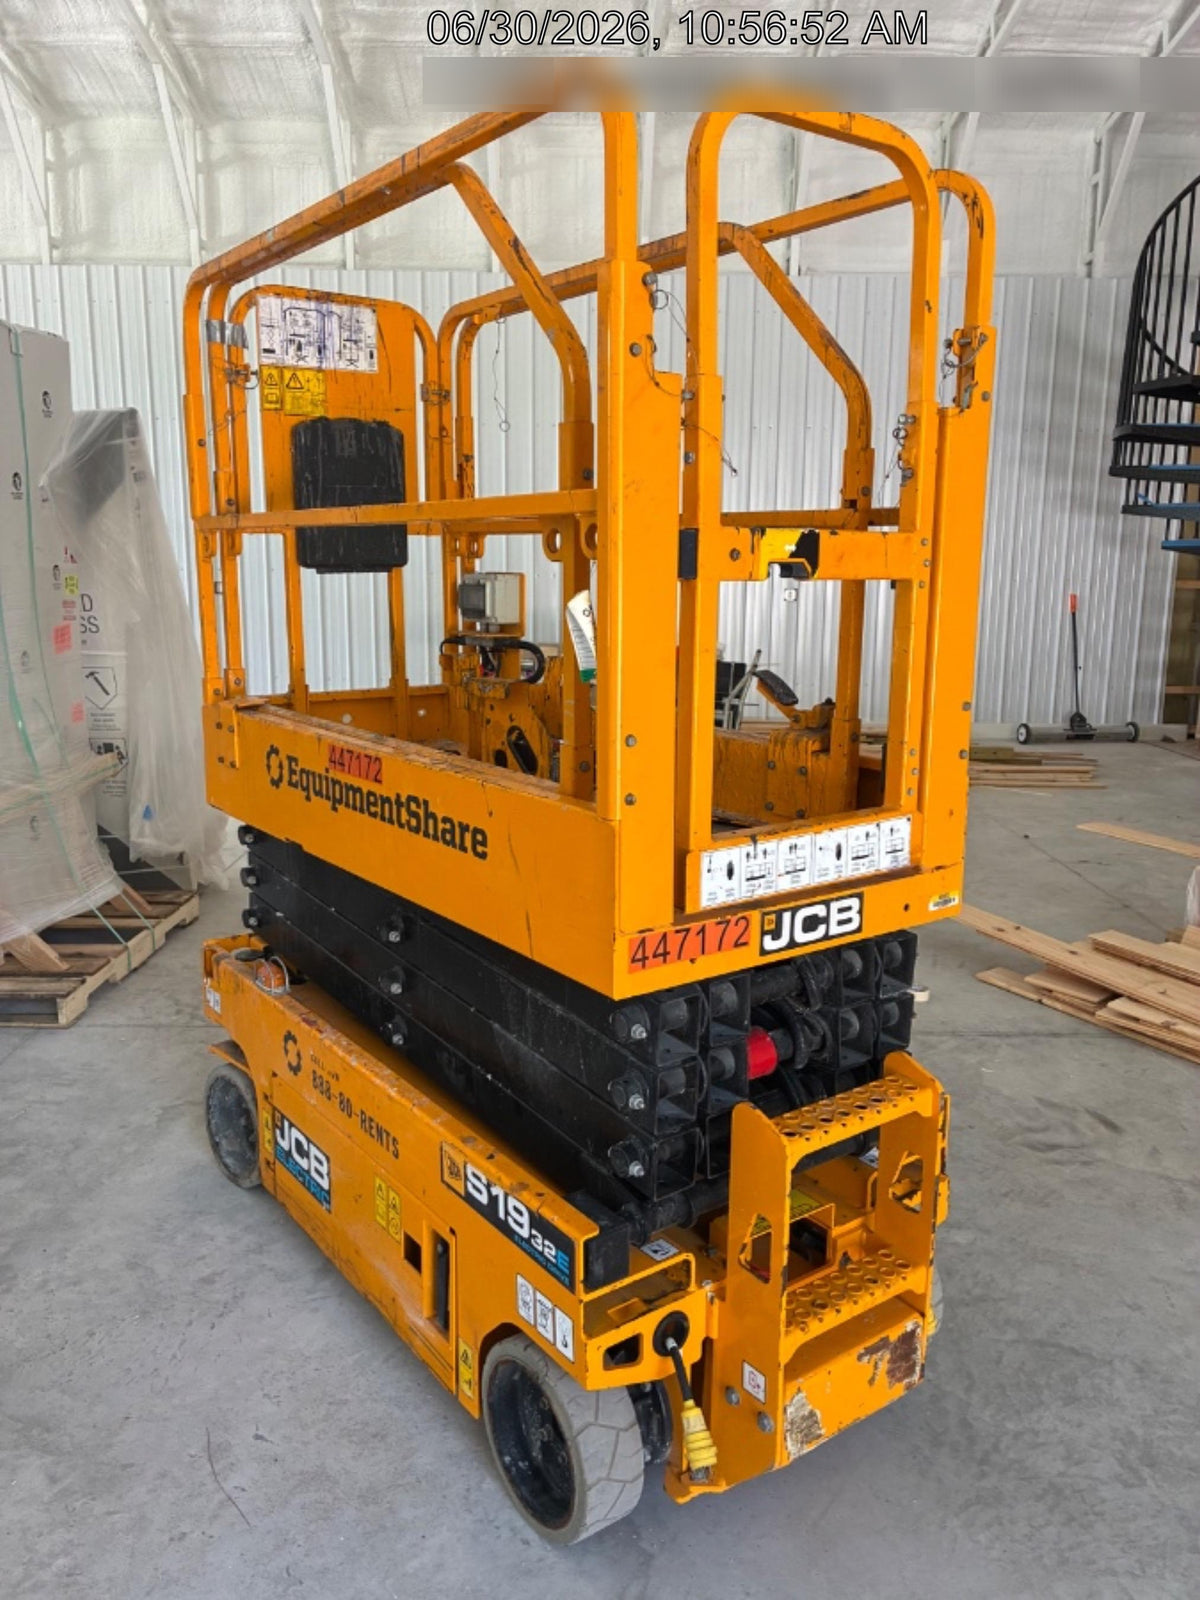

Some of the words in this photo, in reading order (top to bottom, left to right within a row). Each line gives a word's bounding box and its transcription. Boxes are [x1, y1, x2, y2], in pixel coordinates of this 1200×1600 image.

[328, 744, 383, 784] 447172
[286, 754, 489, 861] EquipmentShare
[630, 916, 750, 970] 447172
[762, 897, 861, 951] JCB
[311, 1069, 400, 1160] 888-80-RENTS
[275, 1117, 331, 1190] JCB
